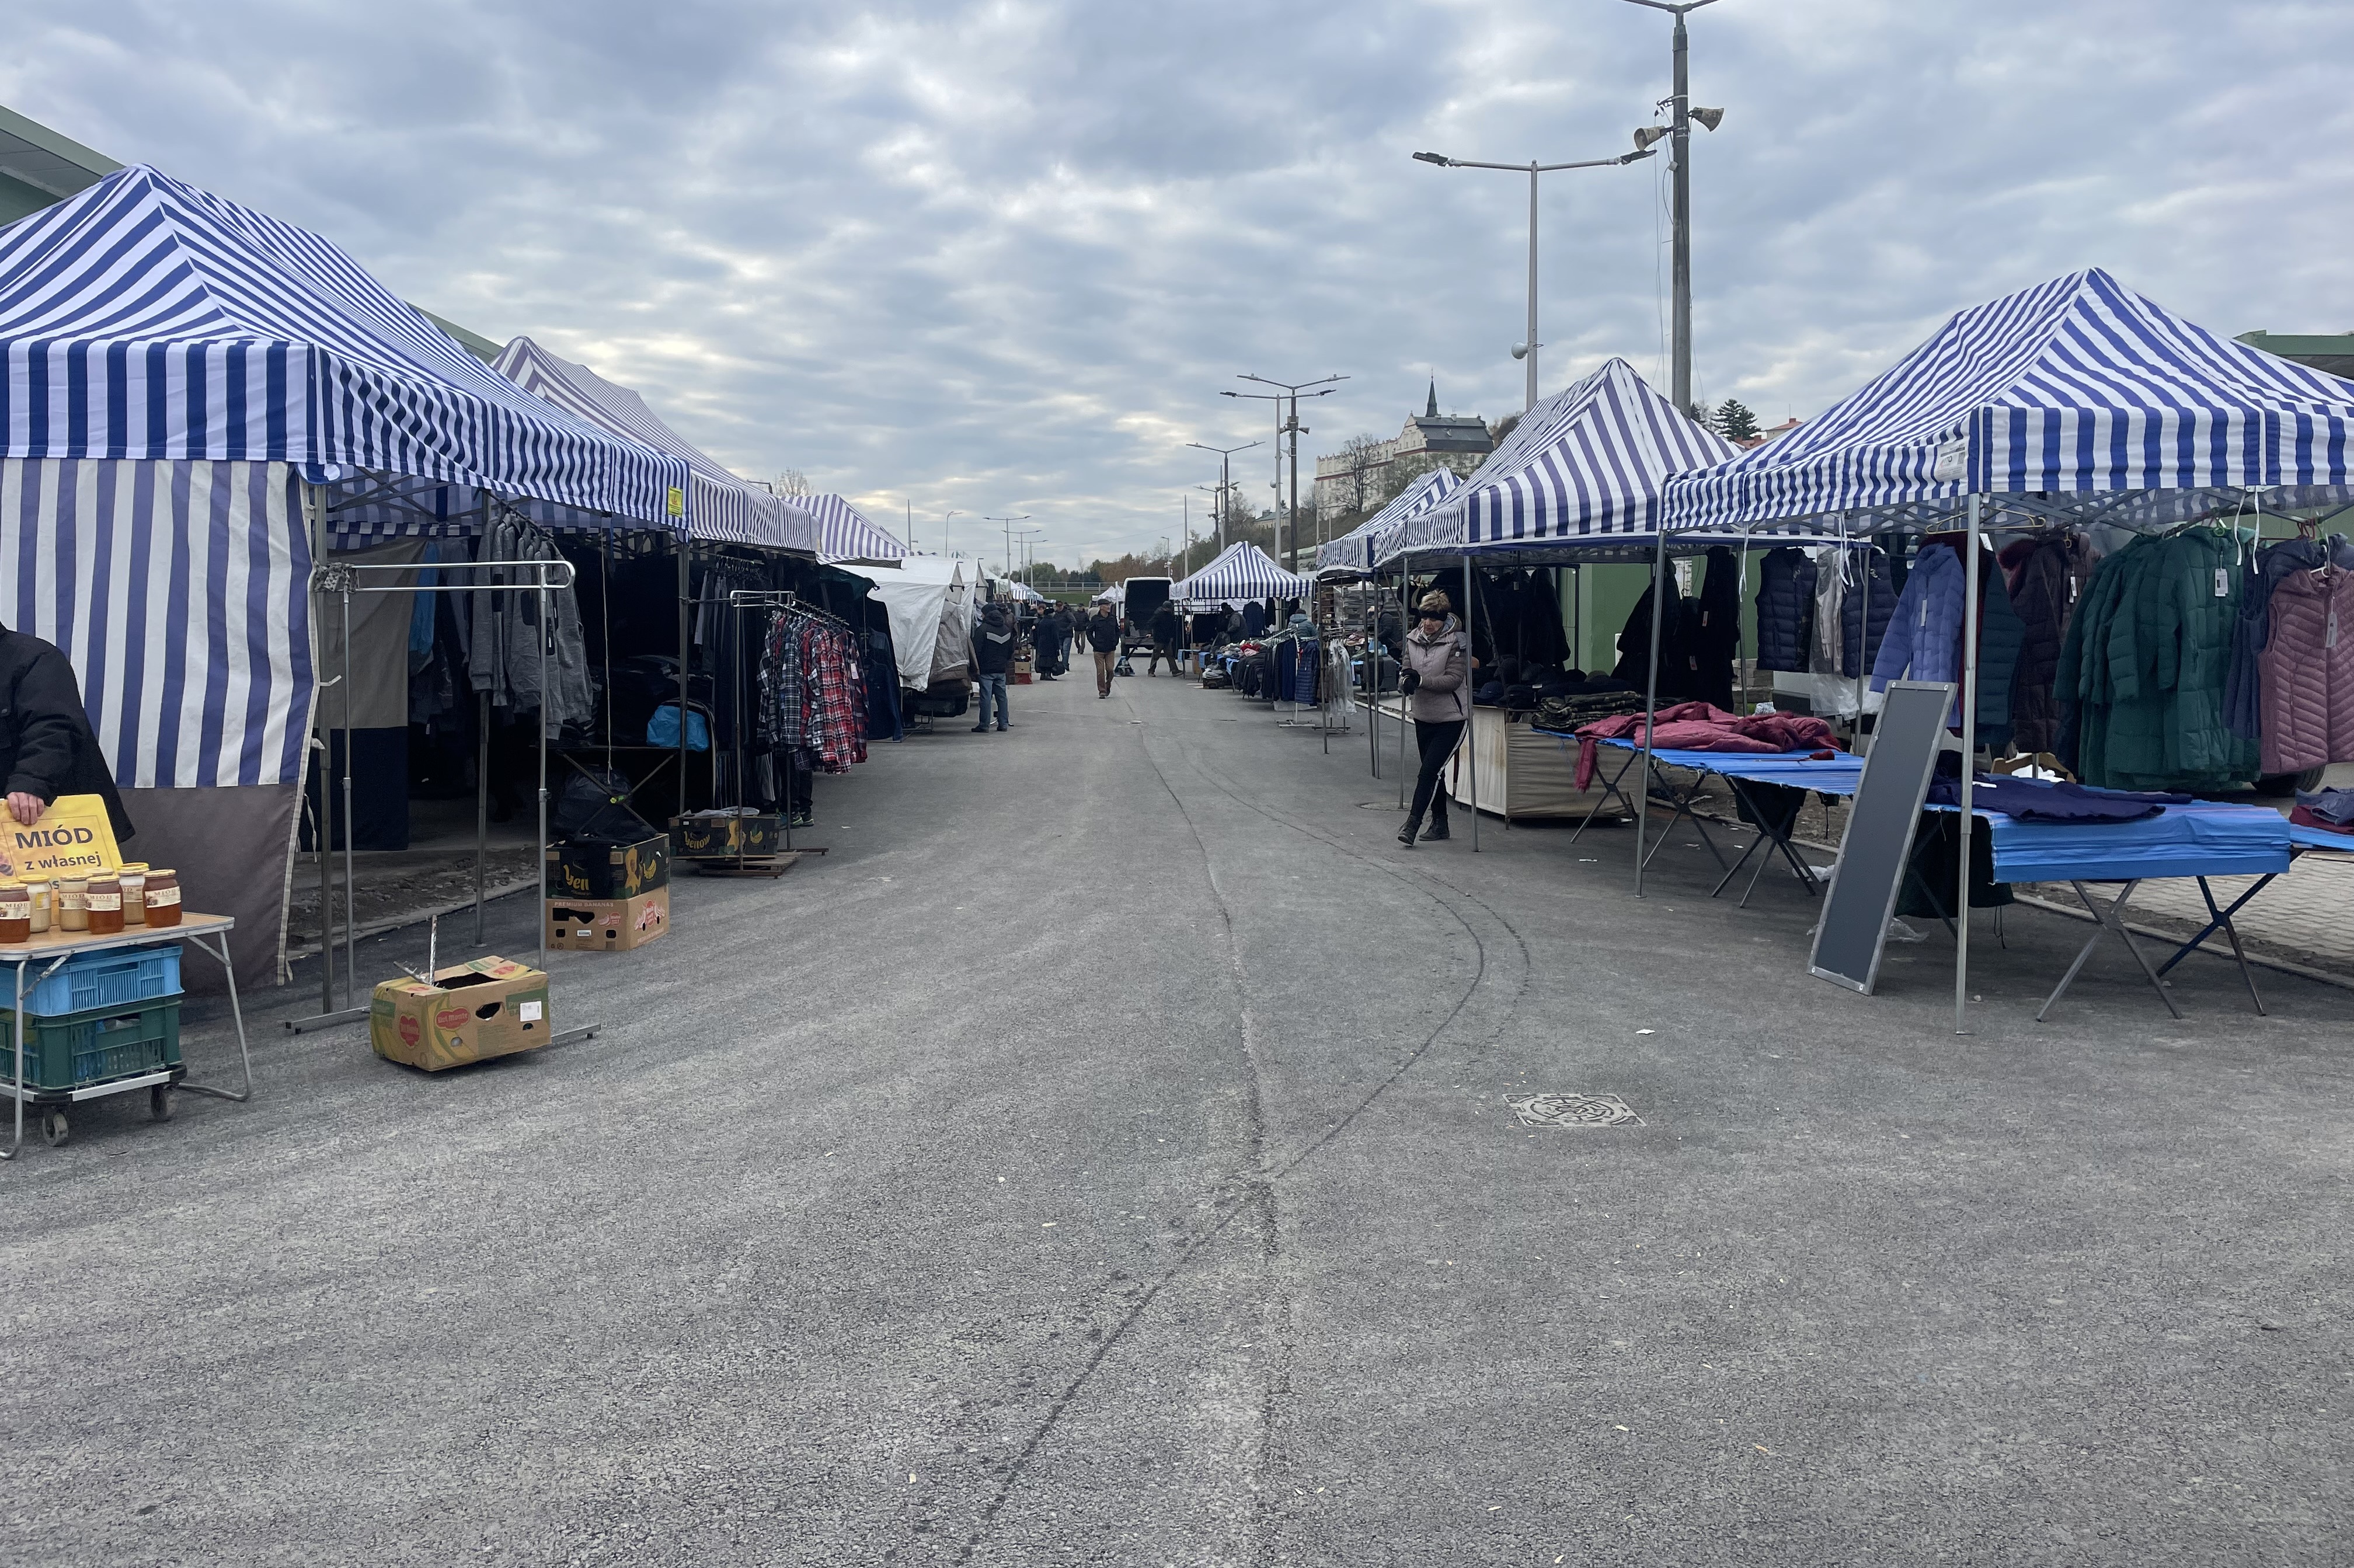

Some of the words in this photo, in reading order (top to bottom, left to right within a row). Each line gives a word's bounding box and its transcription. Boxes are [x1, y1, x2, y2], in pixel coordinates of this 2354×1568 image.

[15, 824, 93, 849] MIÓD
[25, 861, 34, 870] z
[38, 851, 102, 869] własnej
